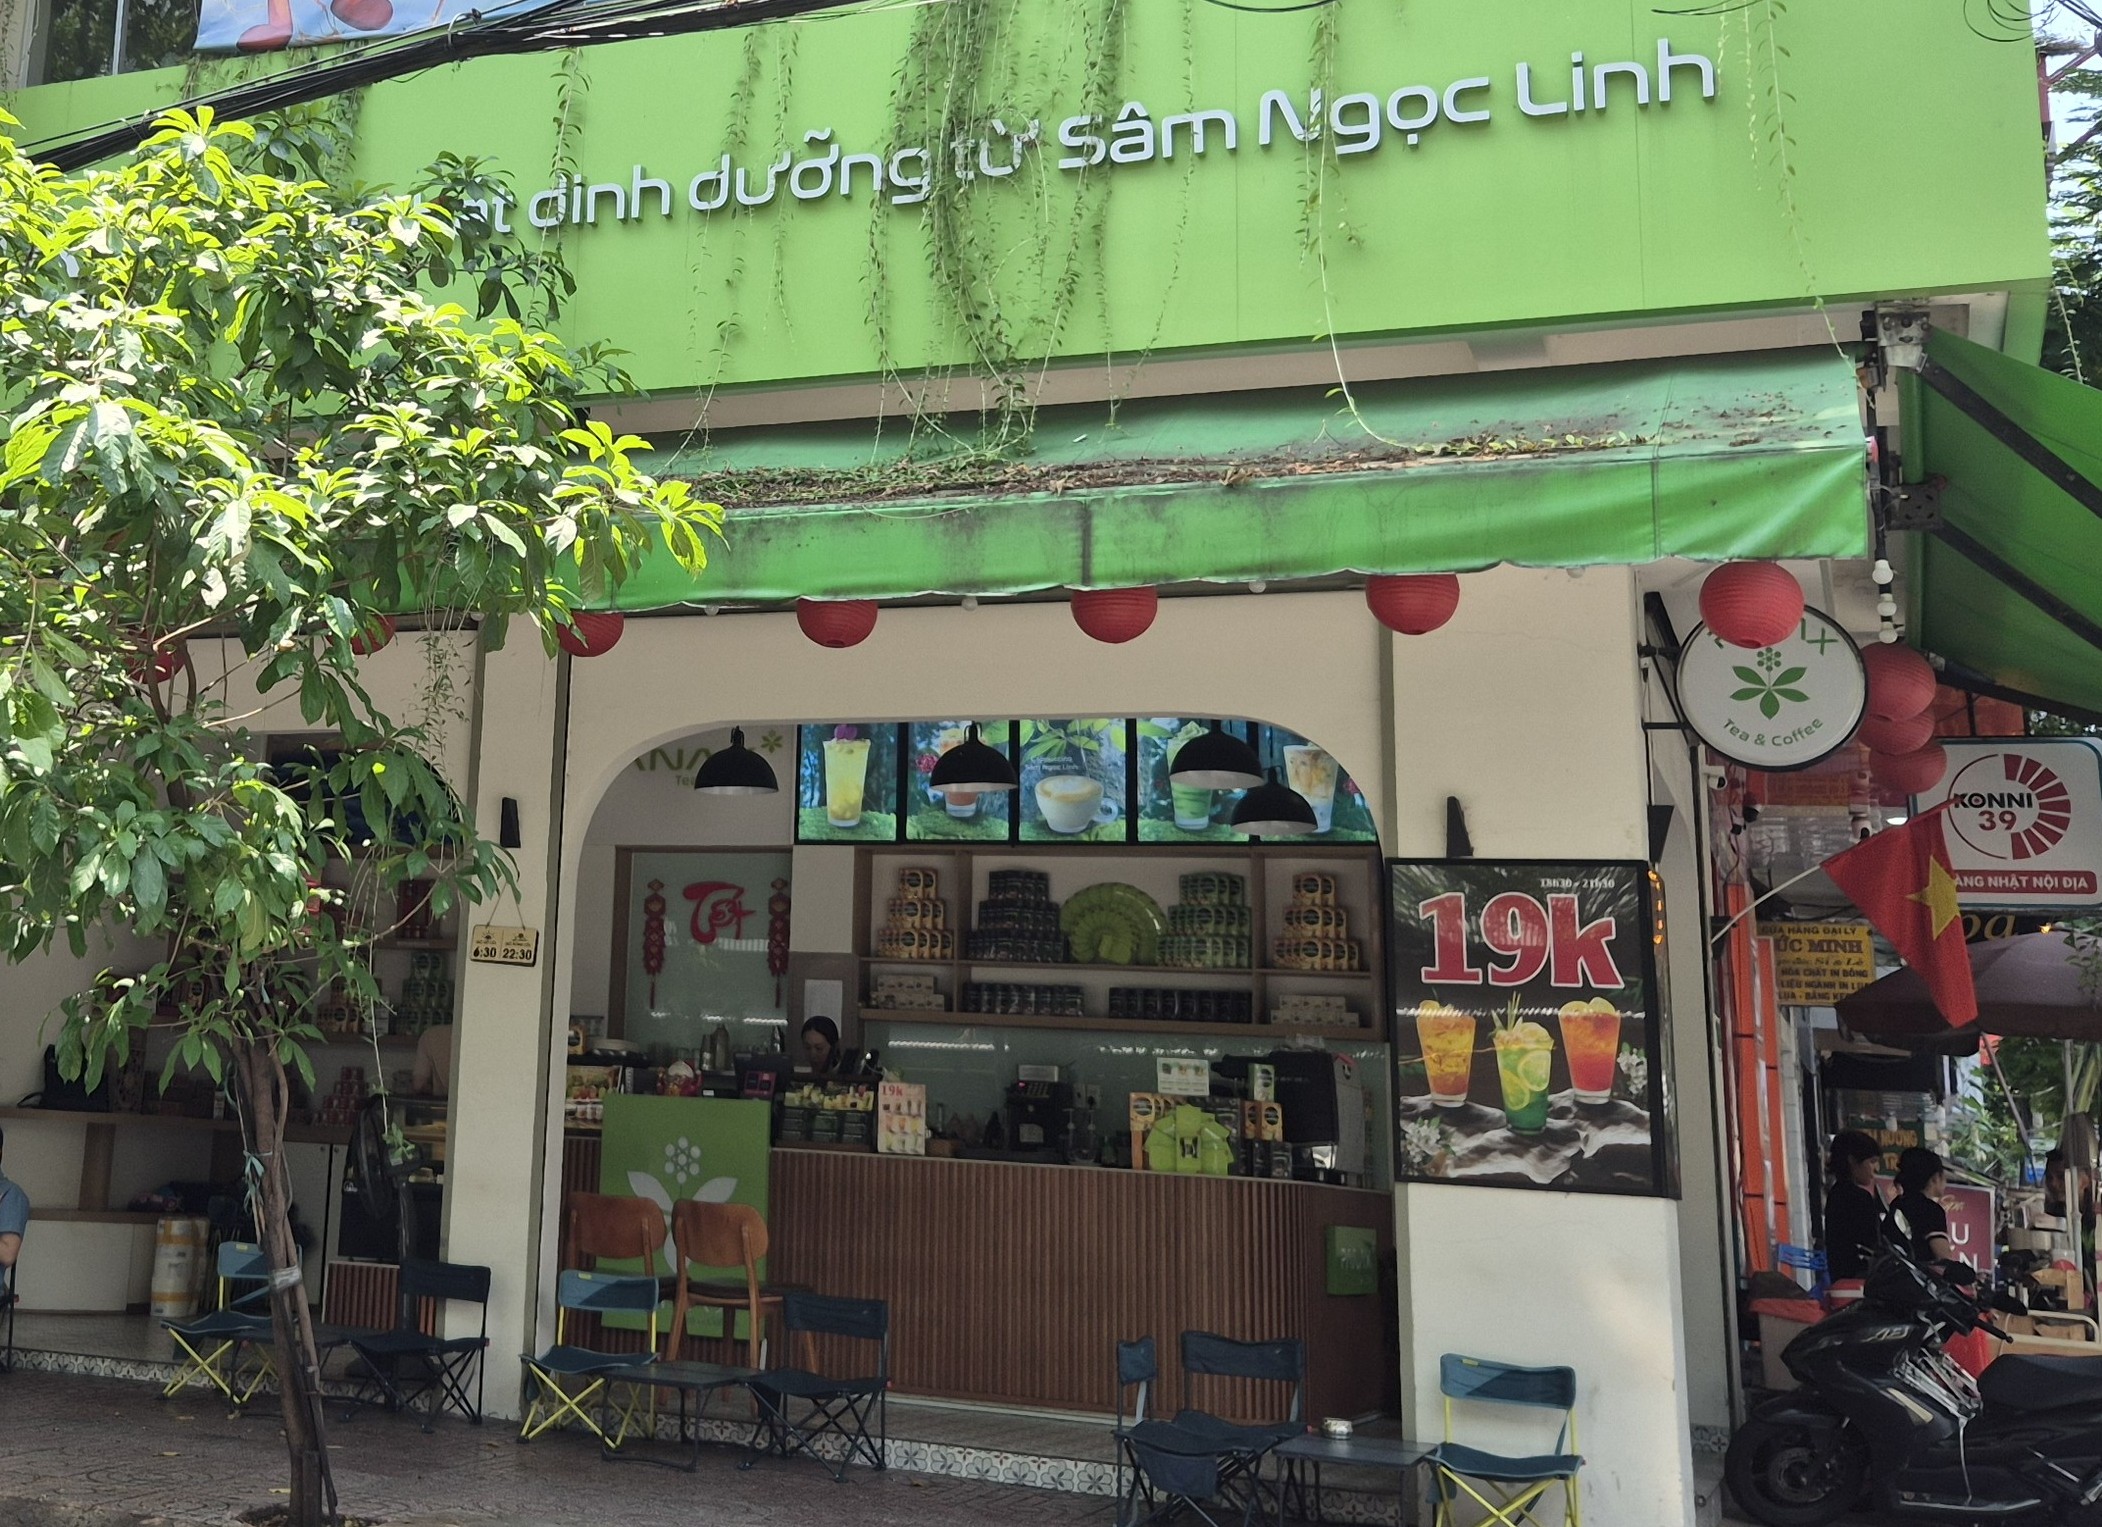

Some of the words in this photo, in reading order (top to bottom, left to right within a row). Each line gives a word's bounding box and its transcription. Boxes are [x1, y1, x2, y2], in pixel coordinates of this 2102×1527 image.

[689, 127, 931, 211] dưỡng
[1058, 101, 1237, 170] Sâm
[1259, 77, 1491, 155] Ngọc
[1515, 38, 1714, 117] Linh
[1722, 718, 1750, 742] Tea
[1754, 734, 1766, 747] &
[1771, 717, 1823, 747] Coffee
[1954, 792, 2033, 809] KONNI
[1978, 810, 2017, 831] 39
[1988, 873, 2029, 890] NHẬT
[2032, 873, 2059, 891] NỘI
[2062, 876, 2089, 891] ĐỊA
[1418, 891, 1625, 989] 19k
[502, 947, 532, 960] 22:30
